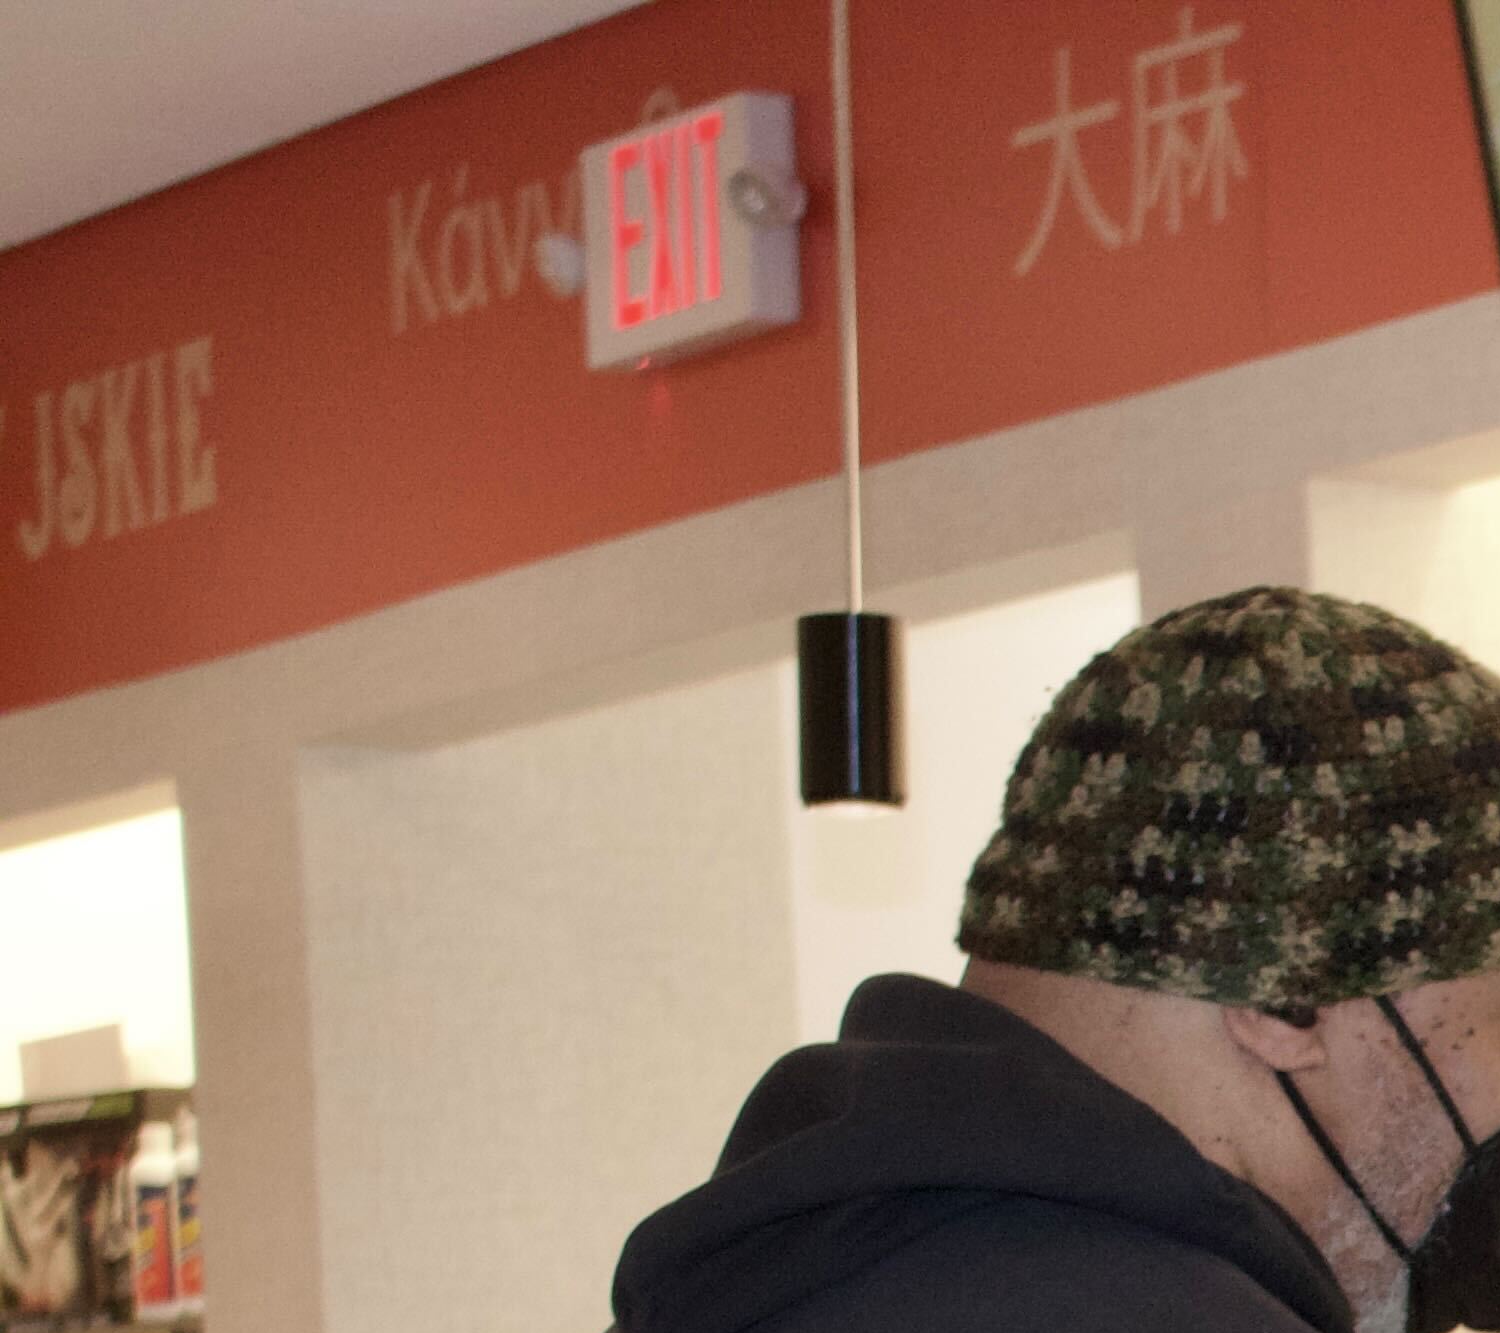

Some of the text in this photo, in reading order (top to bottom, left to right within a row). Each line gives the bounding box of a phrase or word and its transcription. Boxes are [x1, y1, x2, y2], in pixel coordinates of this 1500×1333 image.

[611, 111, 724, 331] EXIT
[1010, 8, 1250, 275] 大麻
[0, 334, 218, 562] JSKIE
